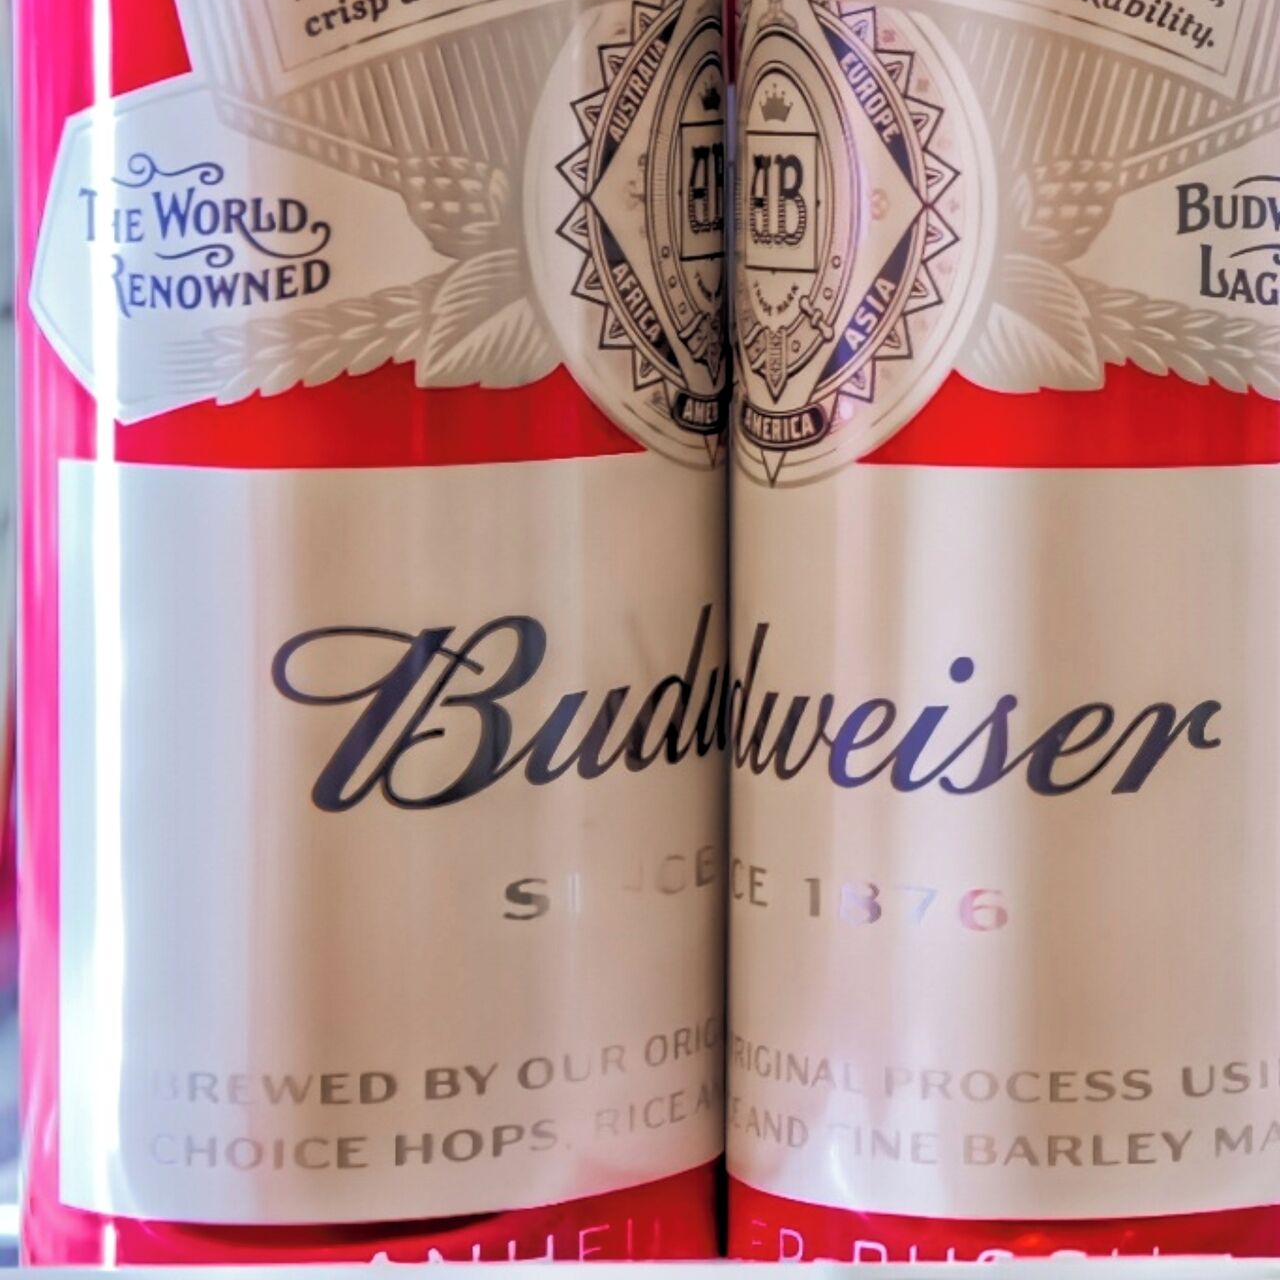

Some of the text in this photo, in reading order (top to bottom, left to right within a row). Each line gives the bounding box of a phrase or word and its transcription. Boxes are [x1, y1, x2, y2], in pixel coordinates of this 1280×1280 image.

[608, 39, 668, 144] AUSTRALIA
[841, 53, 902, 144] EUROPE
[152, 186, 331, 257] WORLD
[611, 262, 662, 346] AFRICA
[844, 279, 898, 353] ASIA
[744, 405, 816, 442] AMERICA
[152, 1071, 399, 1106] BREWED
[424, 1063, 499, 1101] BY
[517, 1045, 626, 1090] OUR
[884, 1065, 1153, 1104] PROCESS
[150, 1131, 369, 1170] CHOICE
[595, 1089, 686, 1137] RICE
[745, 1105, 809, 1148] AND
[963, 1129, 1194, 1167] BARLEY
